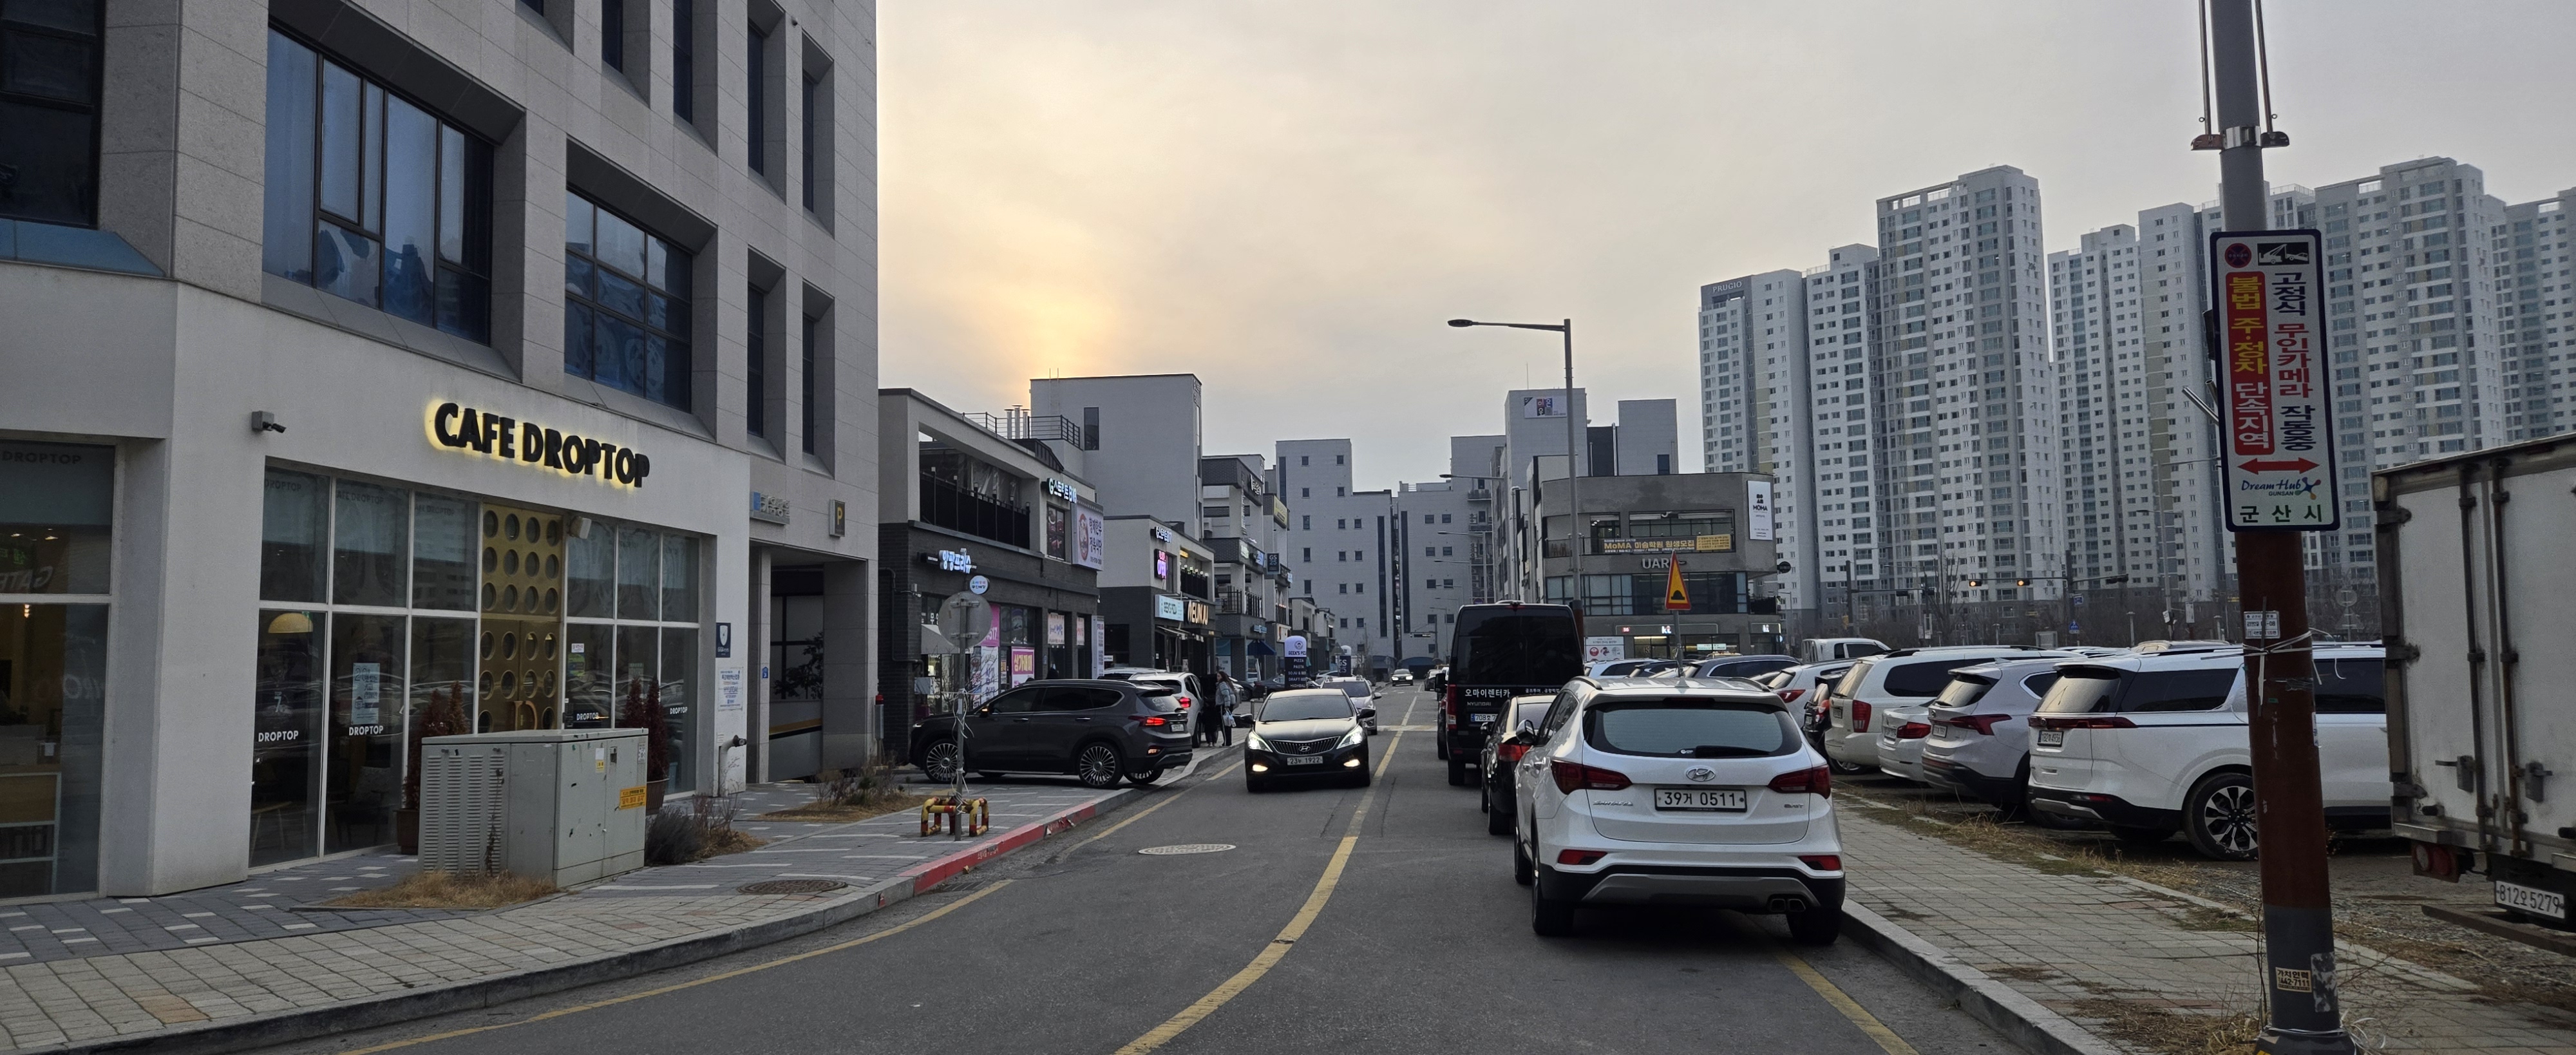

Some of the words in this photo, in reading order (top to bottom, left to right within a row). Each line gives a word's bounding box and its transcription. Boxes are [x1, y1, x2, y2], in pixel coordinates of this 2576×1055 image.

[1712, 281, 1742, 293] PRUGIO
[2230, 276, 2262, 310] 불법
[2271, 272, 2306, 316] 고정식
[2231, 318, 2268, 374] 주·정차
[2274, 323, 2313, 399] 무인카메라
[2235, 382, 2269, 449] 단속지역
[2280, 404, 2316, 451] 작동중
[435, 403, 515, 458] CAFE
[522, 422, 650, 488] DROPTOP
[2, 450, 82, 464] DROPTOP
[2241, 480, 2275, 491] Dream
[2275, 478, 2301, 490] Hub
[837, 506, 843, 525] P
[1634, 540, 1663, 549] 미술학원
[1662, 625, 1671, 634] kt
[1763, 624, 1770, 632] kt
[1014, 654, 1032, 672] 상가매매
[1464, 689, 1511, 698] 오마이렌터카
[576, 712, 599, 721] DROPTOP
[669, 706, 688, 715] DROPTOP
[258, 730, 299, 742] DROPTOP
[348, 725, 384, 736] DROPTOP
[1664, 792, 1692, 805] 39거
[1699, 793, 1735, 806] 0511
[2499, 884, 2528, 906] 812오
[2530, 891, 2560, 914] 5279
[2277, 969, 2309, 979] 가치인력
